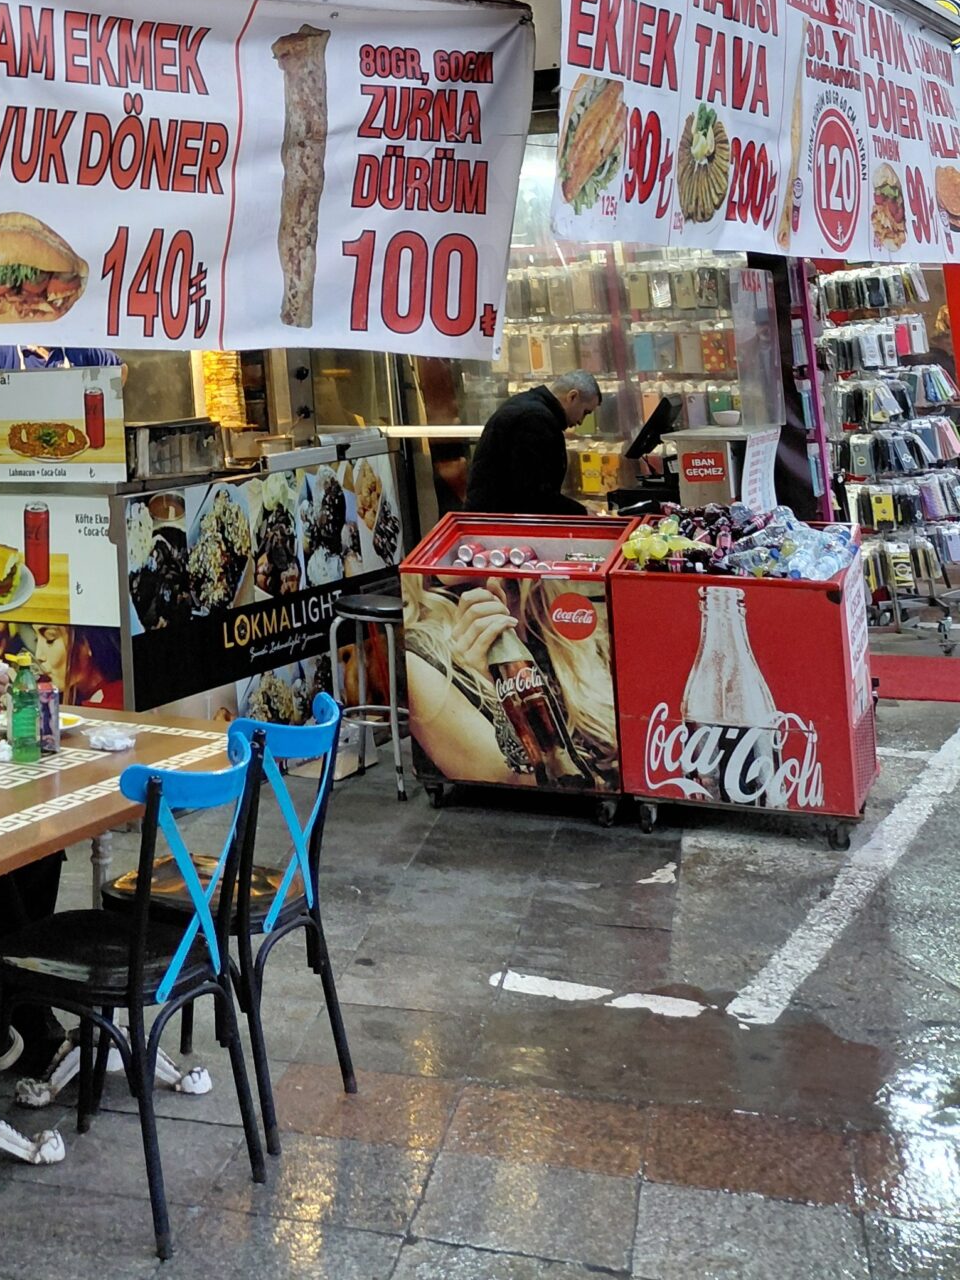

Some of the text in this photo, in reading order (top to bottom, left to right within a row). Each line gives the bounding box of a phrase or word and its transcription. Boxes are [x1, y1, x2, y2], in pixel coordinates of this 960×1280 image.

[63, 9, 211, 96] EKMEK
[432, 48, 495, 85] 60CM
[694, 23, 770, 117] TAVA
[76, 92, 230, 196] DÖNER
[357, 83, 483, 145] ZURNA
[350, 146, 489, 216] DÜRÜM
[817, 143, 856, 213] 120
[857, 137, 867, 181] AYRAN
[741, 269, 762, 293] KASA
[685, 466, 724, 478] GEÇMEZ
[691, 457, 715, 467] IBAN
[644, 701, 824, 808] Coca-Cola
